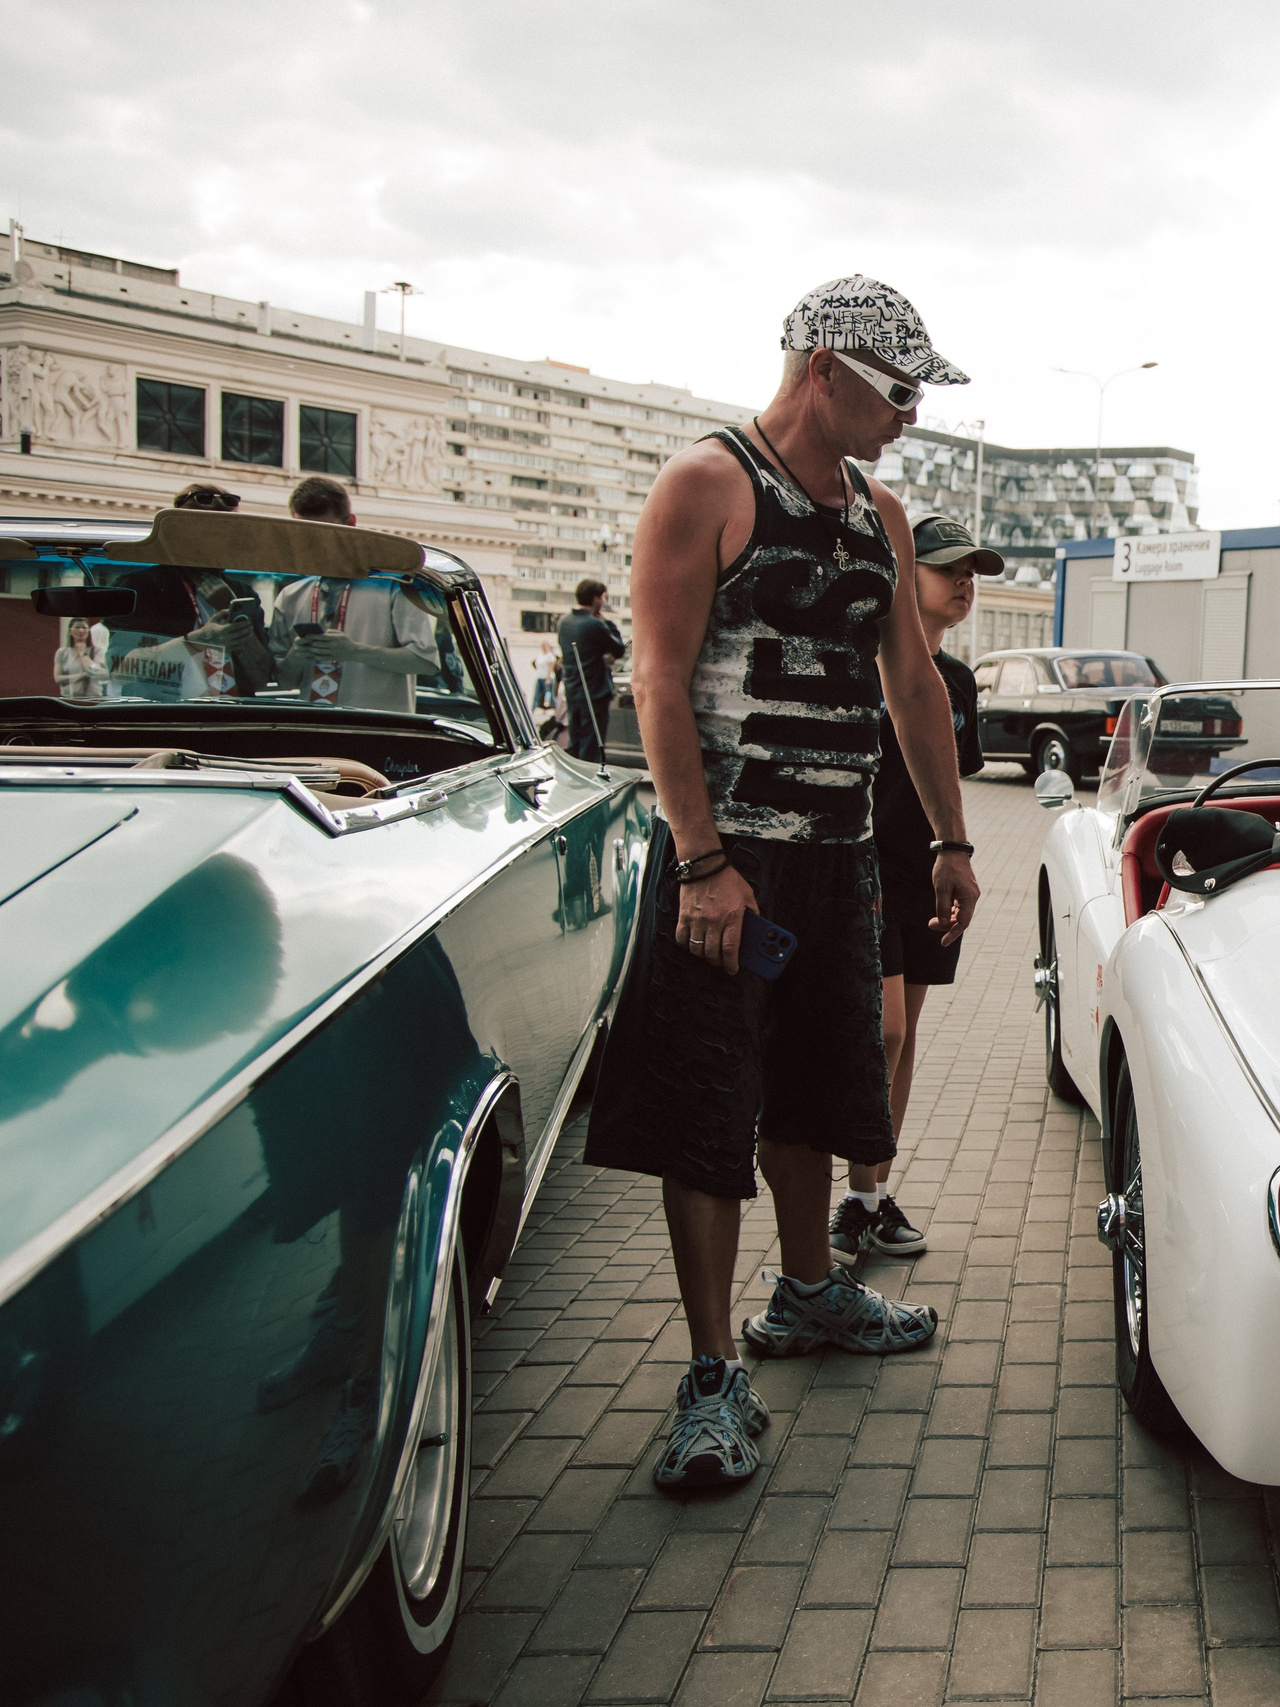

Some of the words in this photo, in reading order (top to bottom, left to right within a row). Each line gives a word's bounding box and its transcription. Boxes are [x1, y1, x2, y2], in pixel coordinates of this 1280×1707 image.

[1136, 541, 1167, 557] Камера
[1169, 539, 1210, 556] хранения
[1121, 543, 1132, 573] 3
[1135, 562, 1163, 576] Luggage
[1164, 561, 1183, 572] Room
